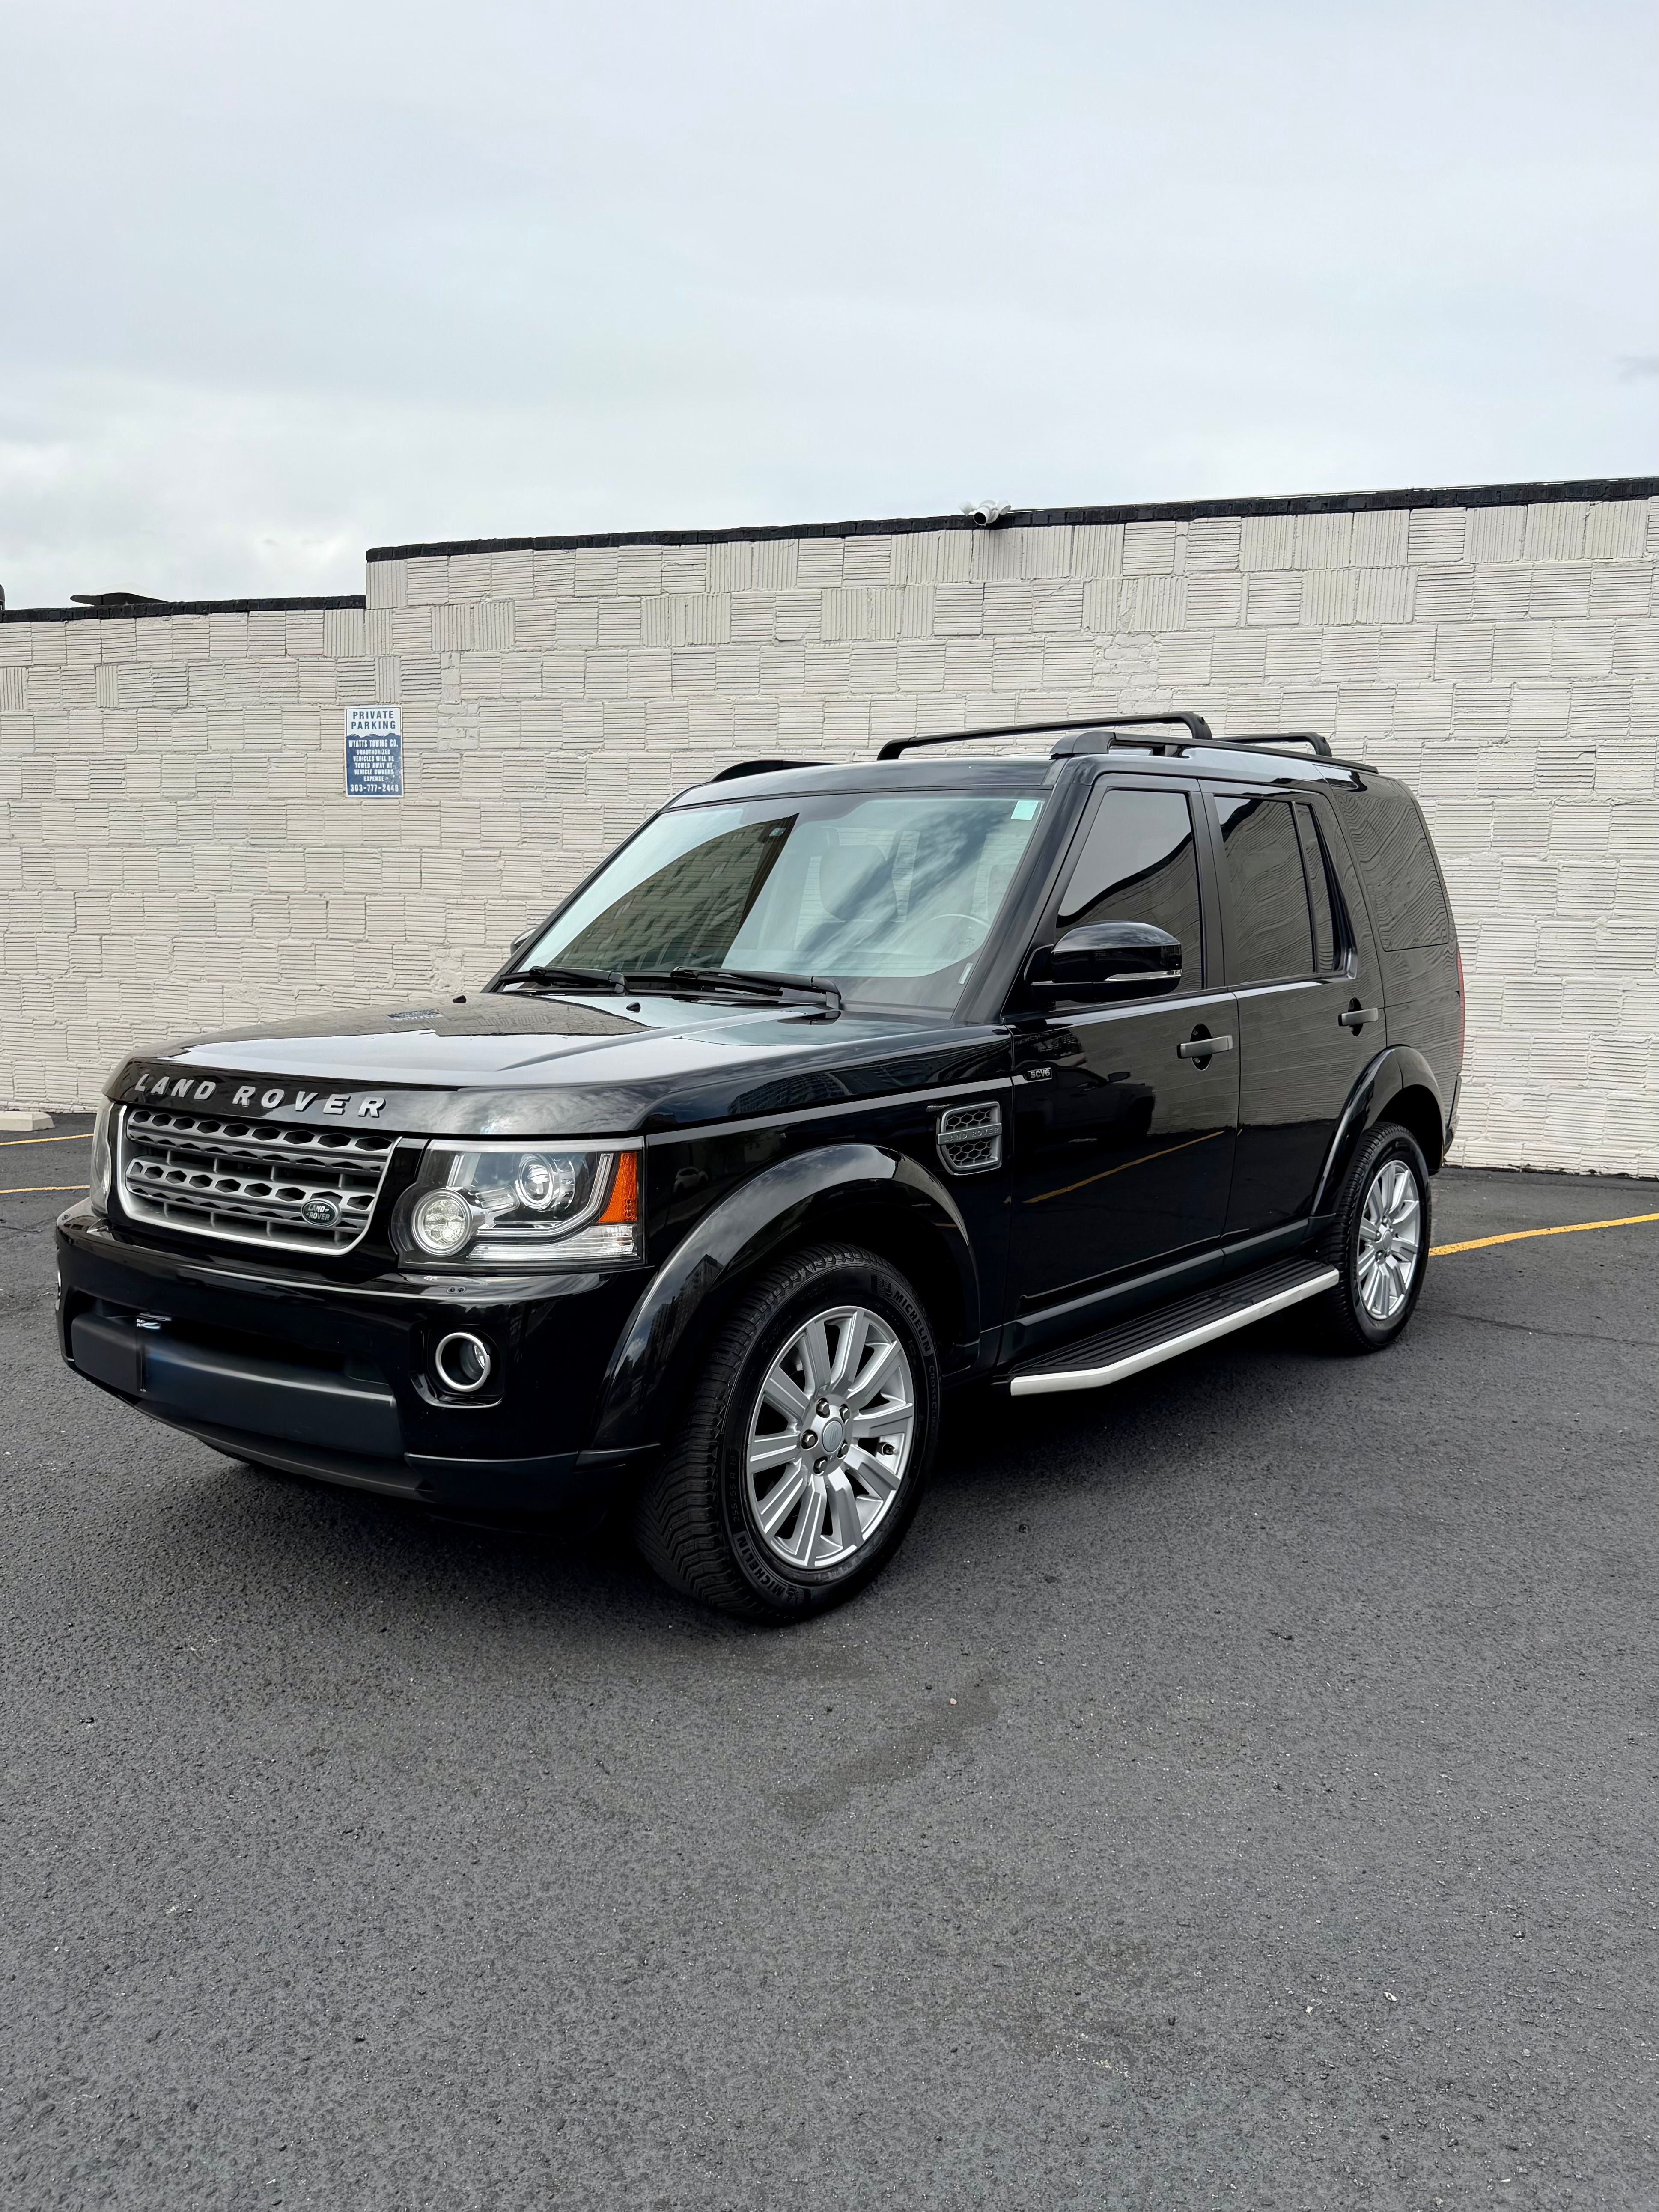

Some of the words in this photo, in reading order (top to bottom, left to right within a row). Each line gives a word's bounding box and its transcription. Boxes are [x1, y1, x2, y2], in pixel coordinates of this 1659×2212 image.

[353, 711, 394, 719] PRIVATE
[351, 721, 396, 729] PARKING
[1031, 1069, 1050, 1078] SCV6
[134, 1074, 217, 1100] LAND
[232, 1086, 385, 1118] ROVER
[944, 1133, 968, 1142] LAND
[972, 1127, 999, 1137] ROVER
[893, 1290, 931, 1352] MICHELIN
[737, 1536, 786, 1597] MICHELIN
